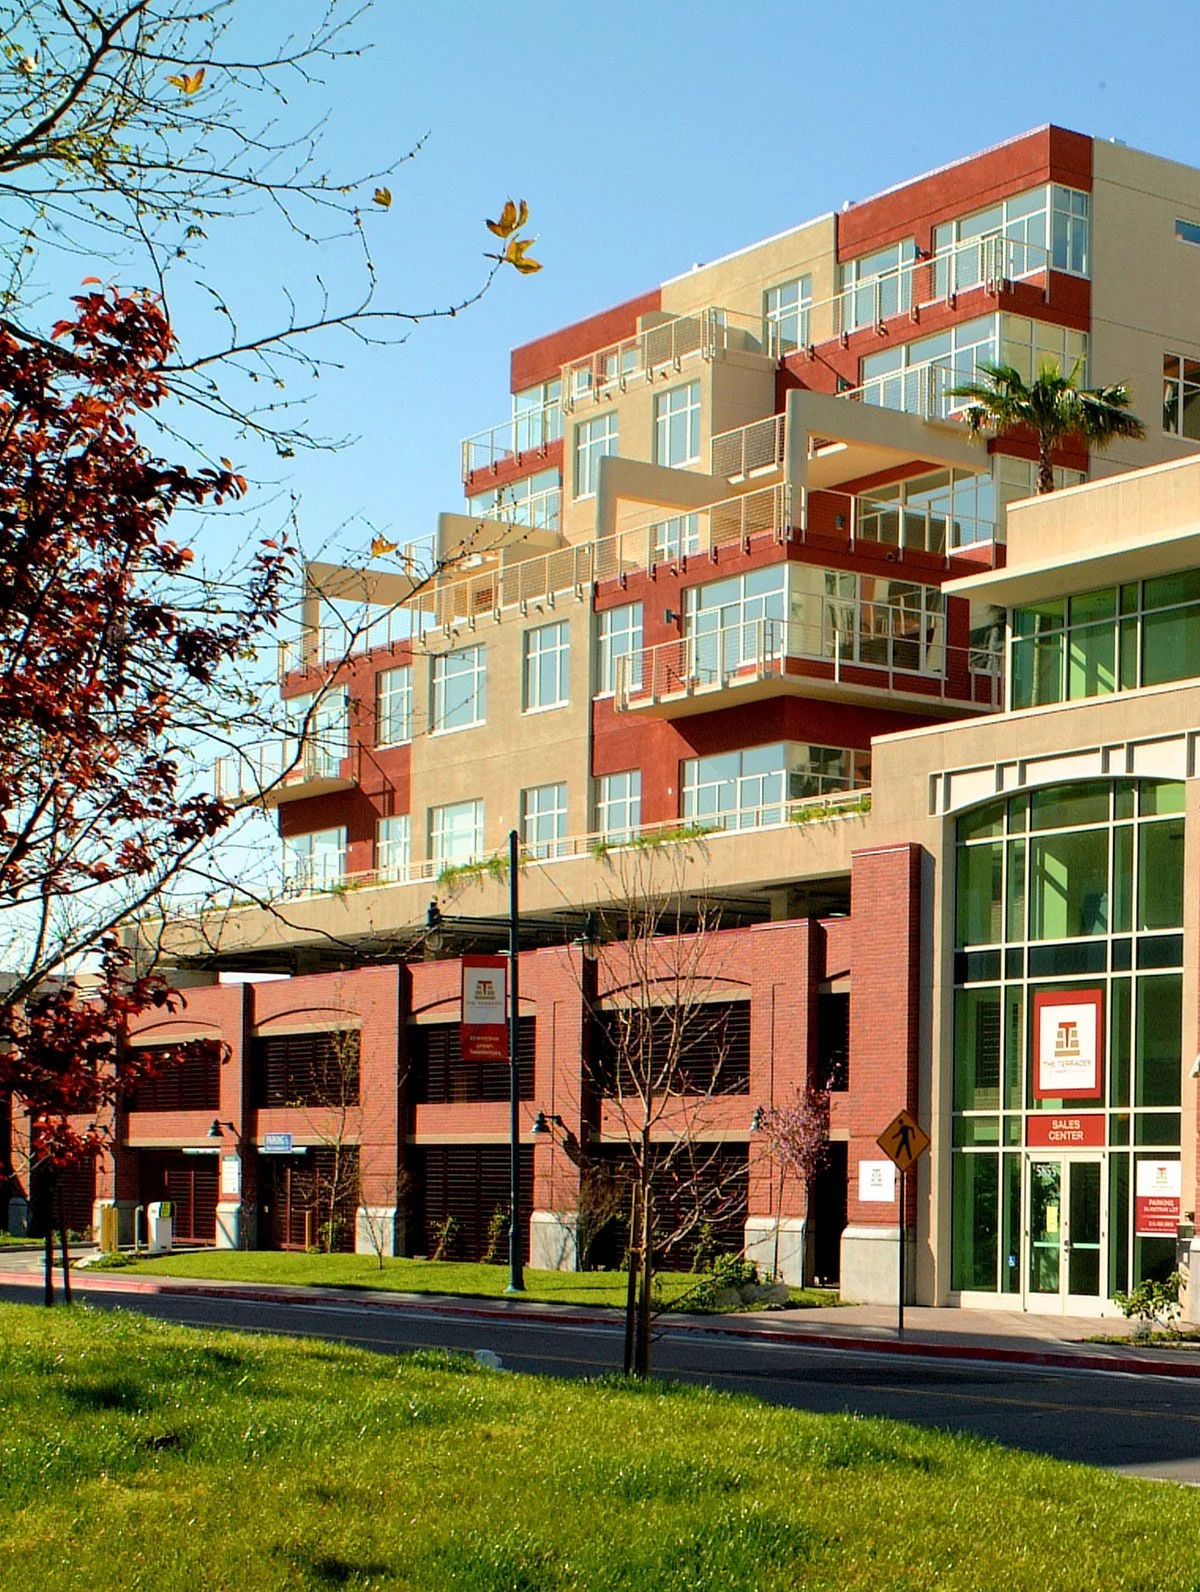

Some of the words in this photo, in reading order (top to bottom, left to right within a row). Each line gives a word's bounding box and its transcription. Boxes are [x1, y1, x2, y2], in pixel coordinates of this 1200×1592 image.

[1043, 1060, 1056, 1068] THE
[1051, 1119, 1081, 1130] SALES
[1048, 1130, 1084, 1141] CENTER
